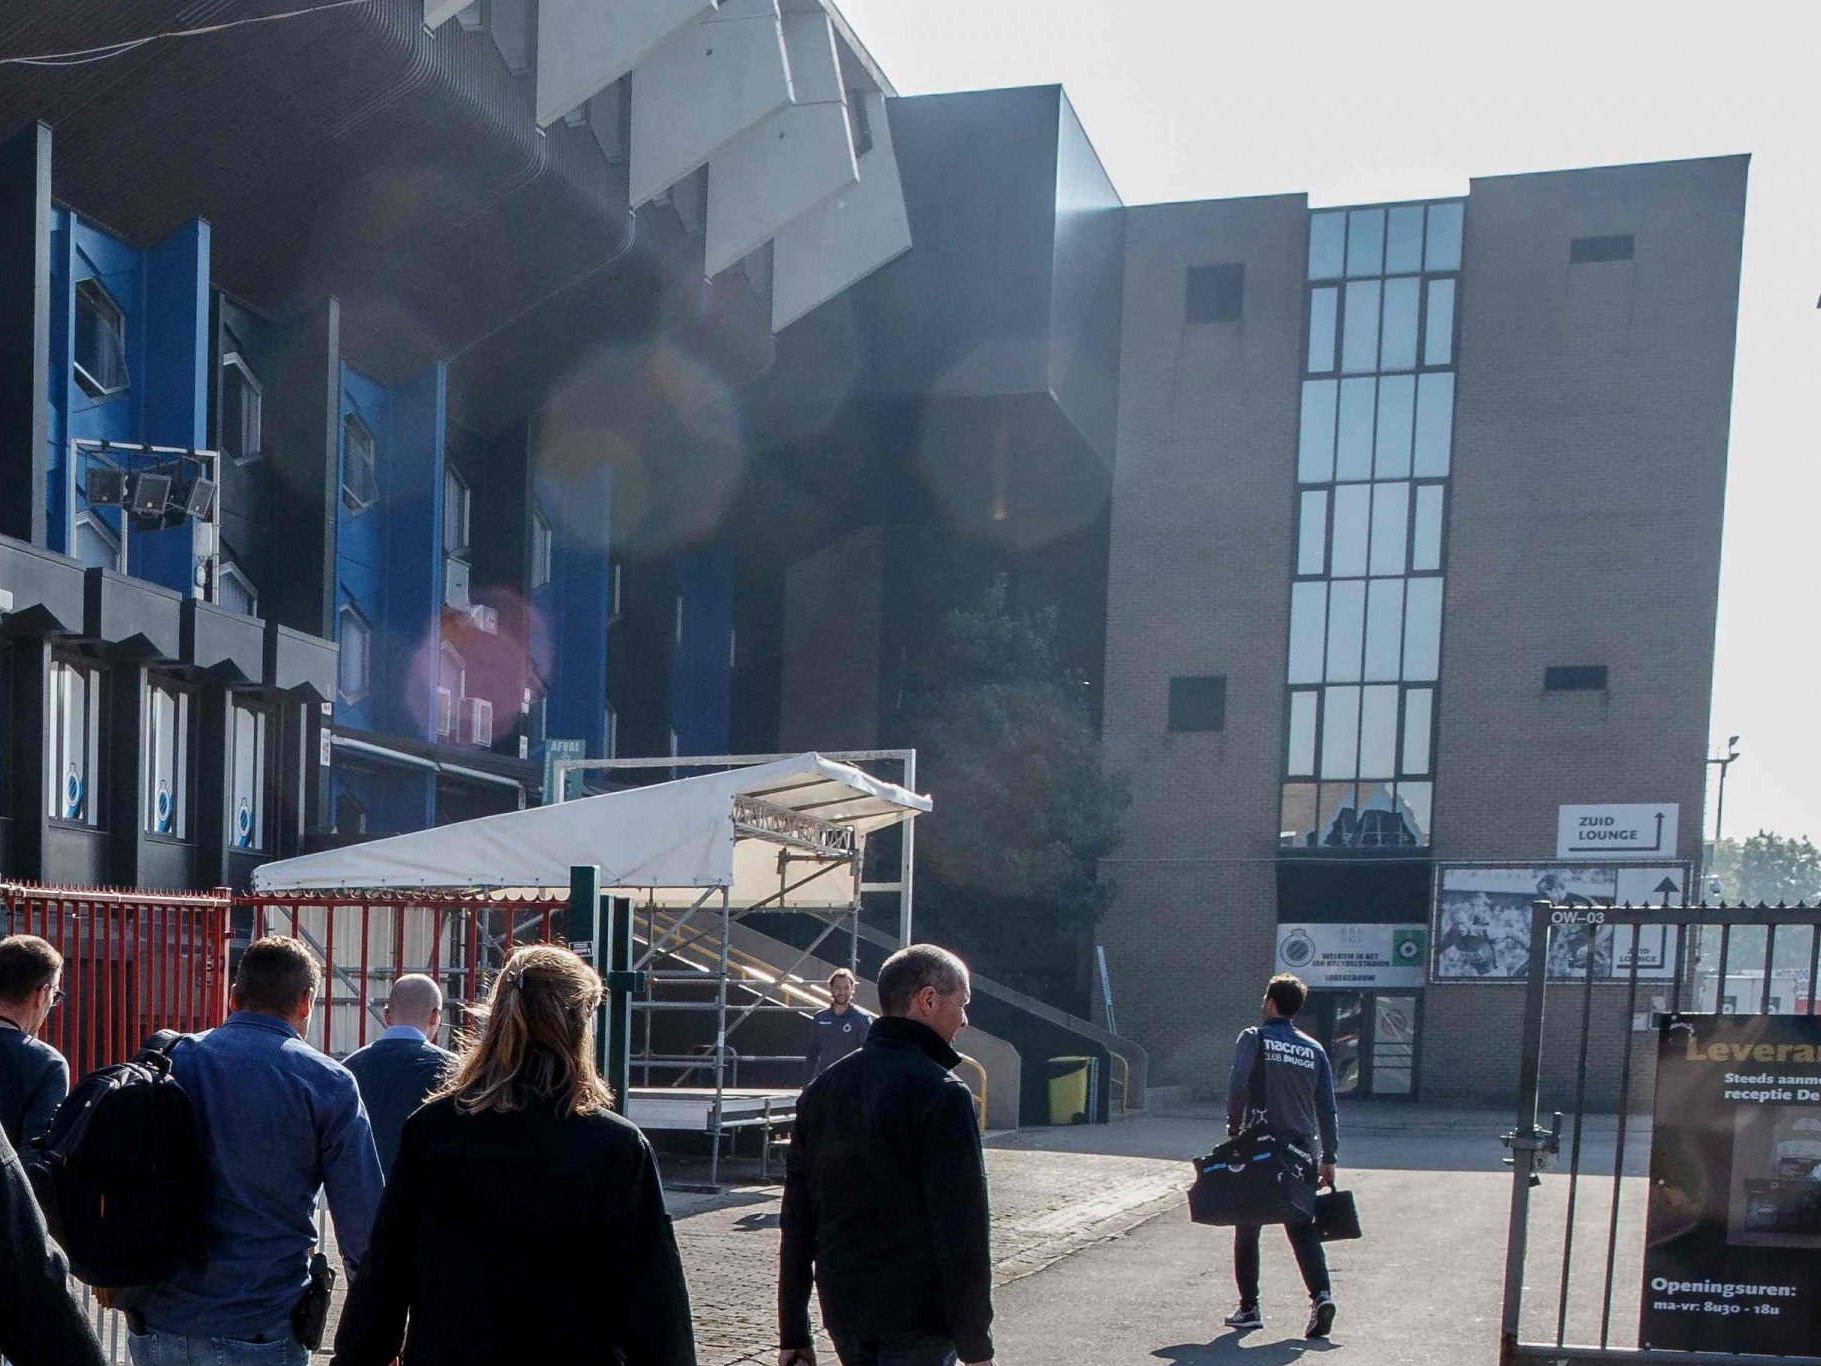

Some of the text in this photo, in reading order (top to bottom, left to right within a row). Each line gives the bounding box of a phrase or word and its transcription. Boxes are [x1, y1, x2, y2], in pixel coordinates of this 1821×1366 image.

[1579, 817, 1614, 827] ZUID
[1579, 830, 1638, 841] LOUNGE
[1685, 1037, 1821, 1062] Levera
[1283, 1054, 1316, 1070] BRUGGE
[1724, 1073, 1774, 1084] Steeds
[1724, 1088, 1821, 1102] receptie De
[1651, 1277, 1797, 1298] Openingsuren:
[1703, 1302, 1741, 1315] 8u30
